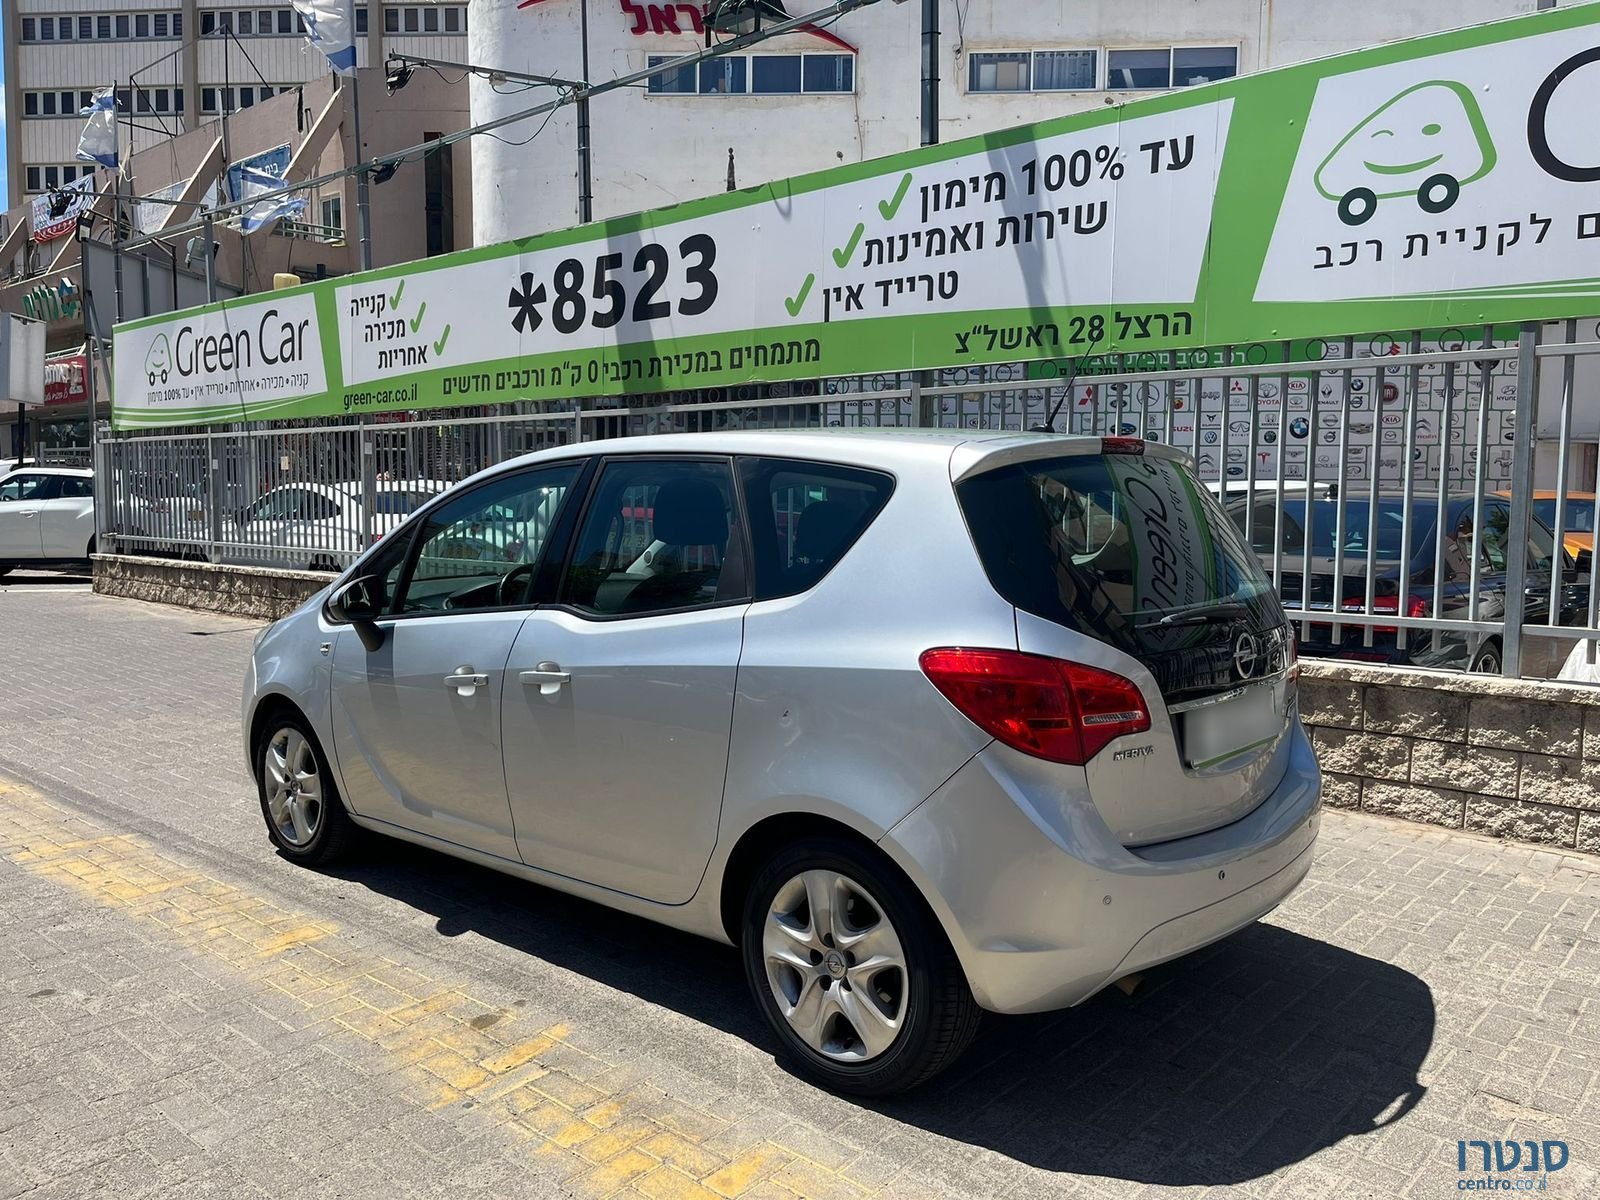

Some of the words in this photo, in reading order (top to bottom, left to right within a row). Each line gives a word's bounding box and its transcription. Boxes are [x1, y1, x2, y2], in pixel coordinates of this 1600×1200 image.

[1140, 134, 1195, 174] עד
[1021, 144, 1125, 196] 100%
[920, 171, 1006, 223] מימון
[995, 200, 1108, 248] שירות
[1403, 213, 1552, 259] לקניית
[863, 220, 984, 268] ואמינות
[1313, 239, 1383, 269] רכב
[874, 270, 959, 307] טרייד
[350, 293, 386, 318] קנייה
[822, 283, 865, 323] אין
[364, 319, 406, 343] מכירה
[1069, 315, 1105, 344] 28
[1114, 310, 1192, 341] הרצל
[176, 326, 251, 377] Green
[259, 310, 309, 365] Car
[377, 345, 428, 369] אחריות
[729, 338, 821, 369] מתמחים
[495, 368, 545, 390] ורכבים
[587, 360, 598, 384] 0
[604, 360, 643, 382] רכבי
[648, 352, 722, 378] במכירת
[164, 388, 181, 401] 100%
[261, 376, 284, 390] מכירה
[290, 372, 309, 390] קניה
[443, 373, 490, 395] חדשים
[343, 383, 418, 411] green-car.co.il
[1113, 745, 1154, 761] MERIVA
